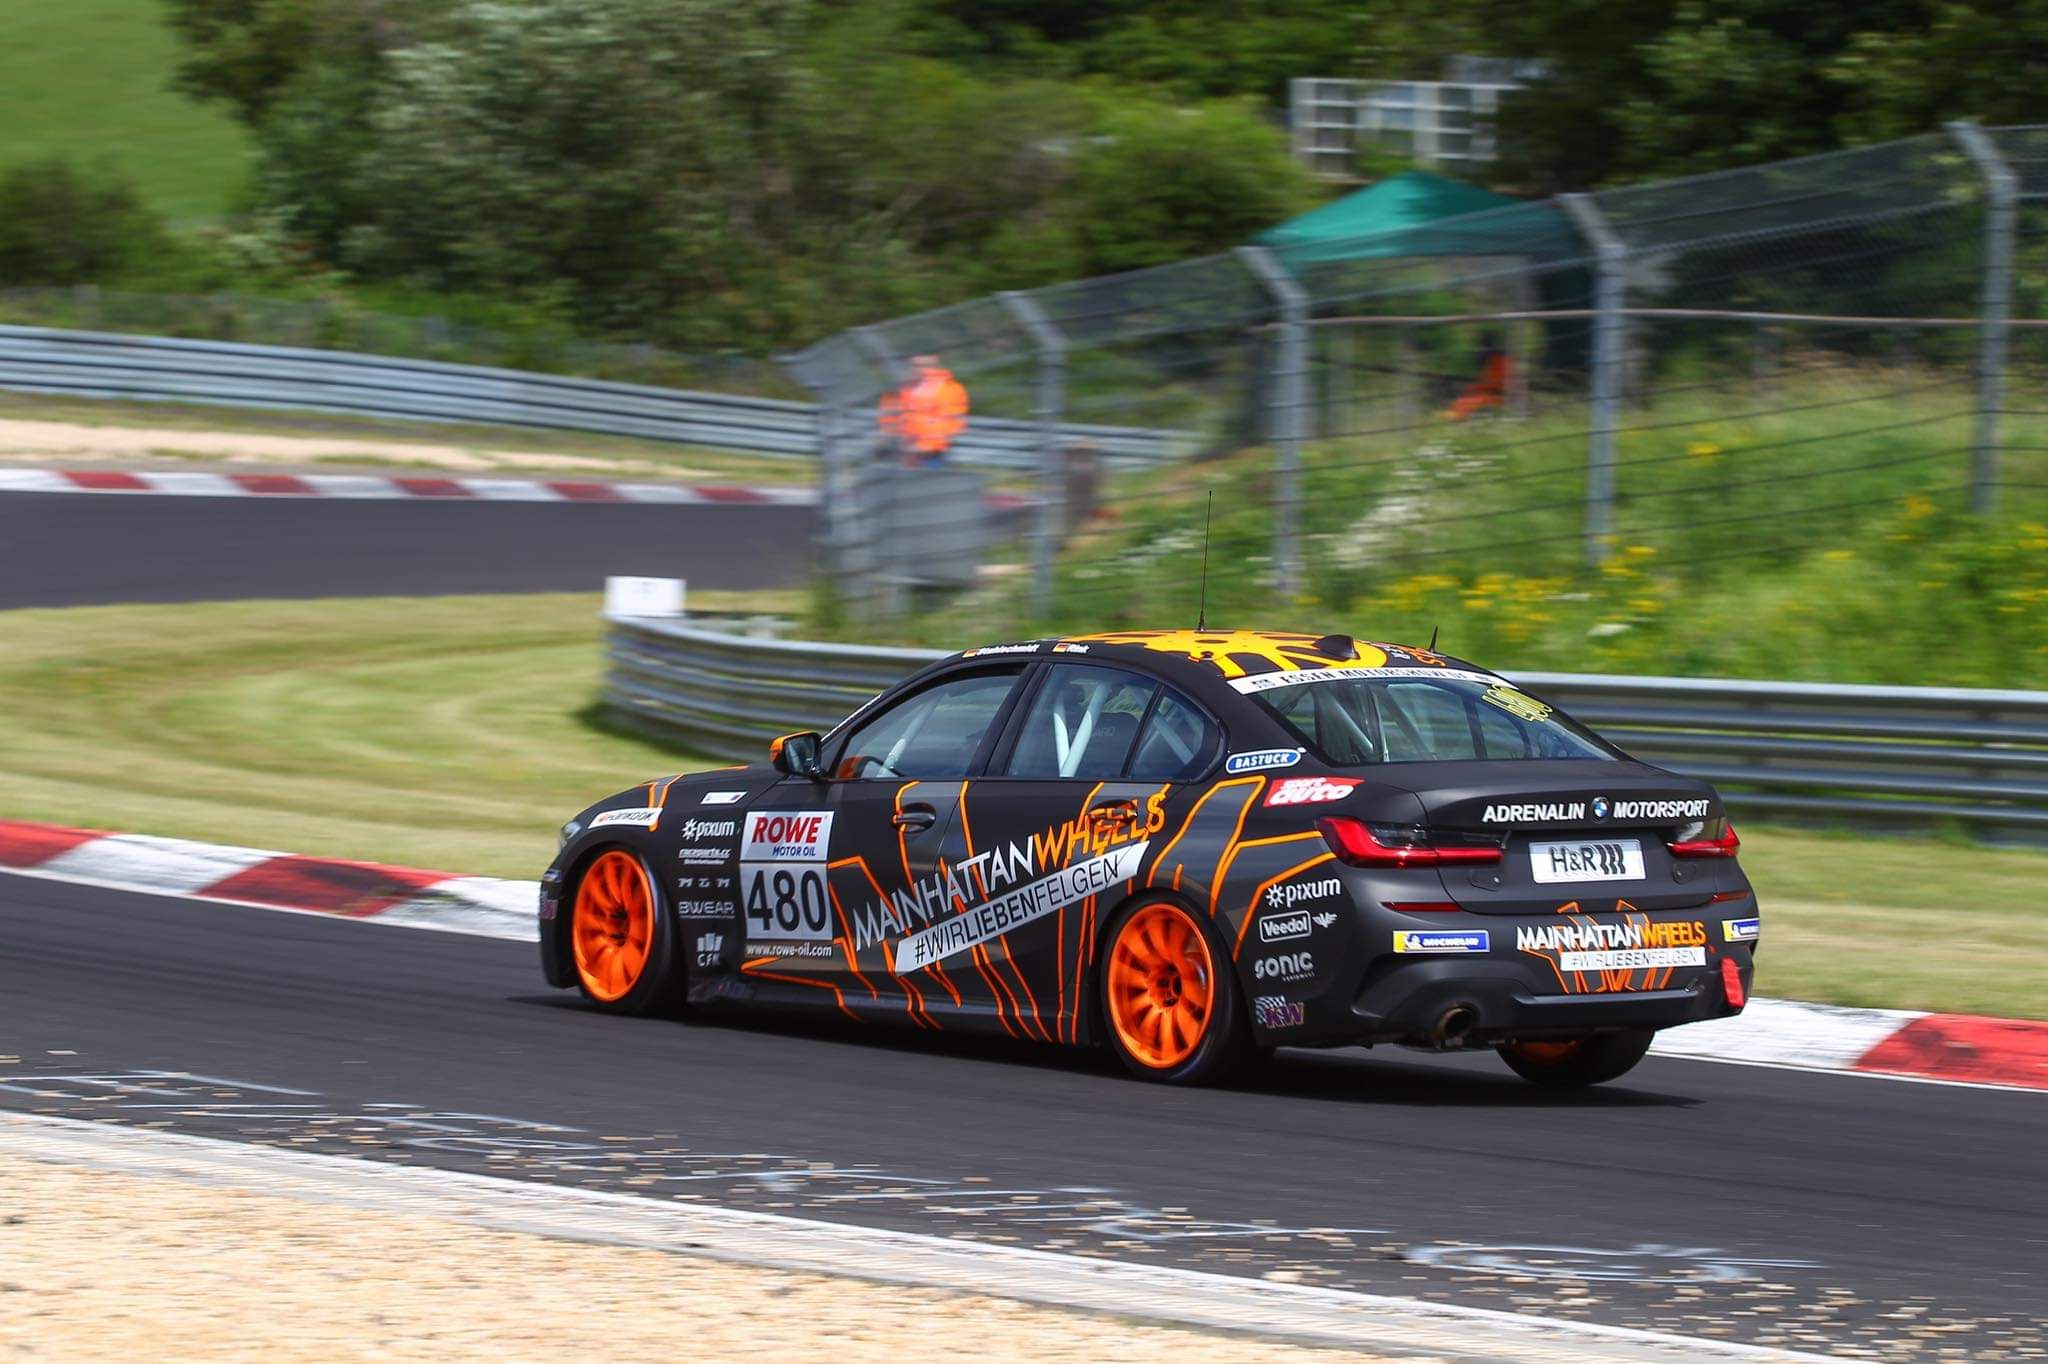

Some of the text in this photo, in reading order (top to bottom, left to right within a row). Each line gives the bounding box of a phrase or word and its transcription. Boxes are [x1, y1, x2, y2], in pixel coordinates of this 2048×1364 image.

[1280, 671, 1336, 684] ESSEN
[1234, 752, 1289, 769] BASTUCK
[1482, 800, 1710, 823] ADRENALIN MOTORSPORT
[695, 820, 736, 842] pixum
[751, 816, 822, 844] ROWE
[772, 846, 817, 857] MOTOR OIL
[1550, 846, 1596, 874] H&R
[748, 869, 828, 933] 480
[1286, 878, 1342, 908] pixum
[913, 853, 1120, 965] #WIRLIEBENFELGEN
[1263, 916, 1308, 937] Veedol
[1516, 921, 1706, 951] MAINHATTANWHEELS
[744, 942, 832, 958] www.rowe-oil.com
